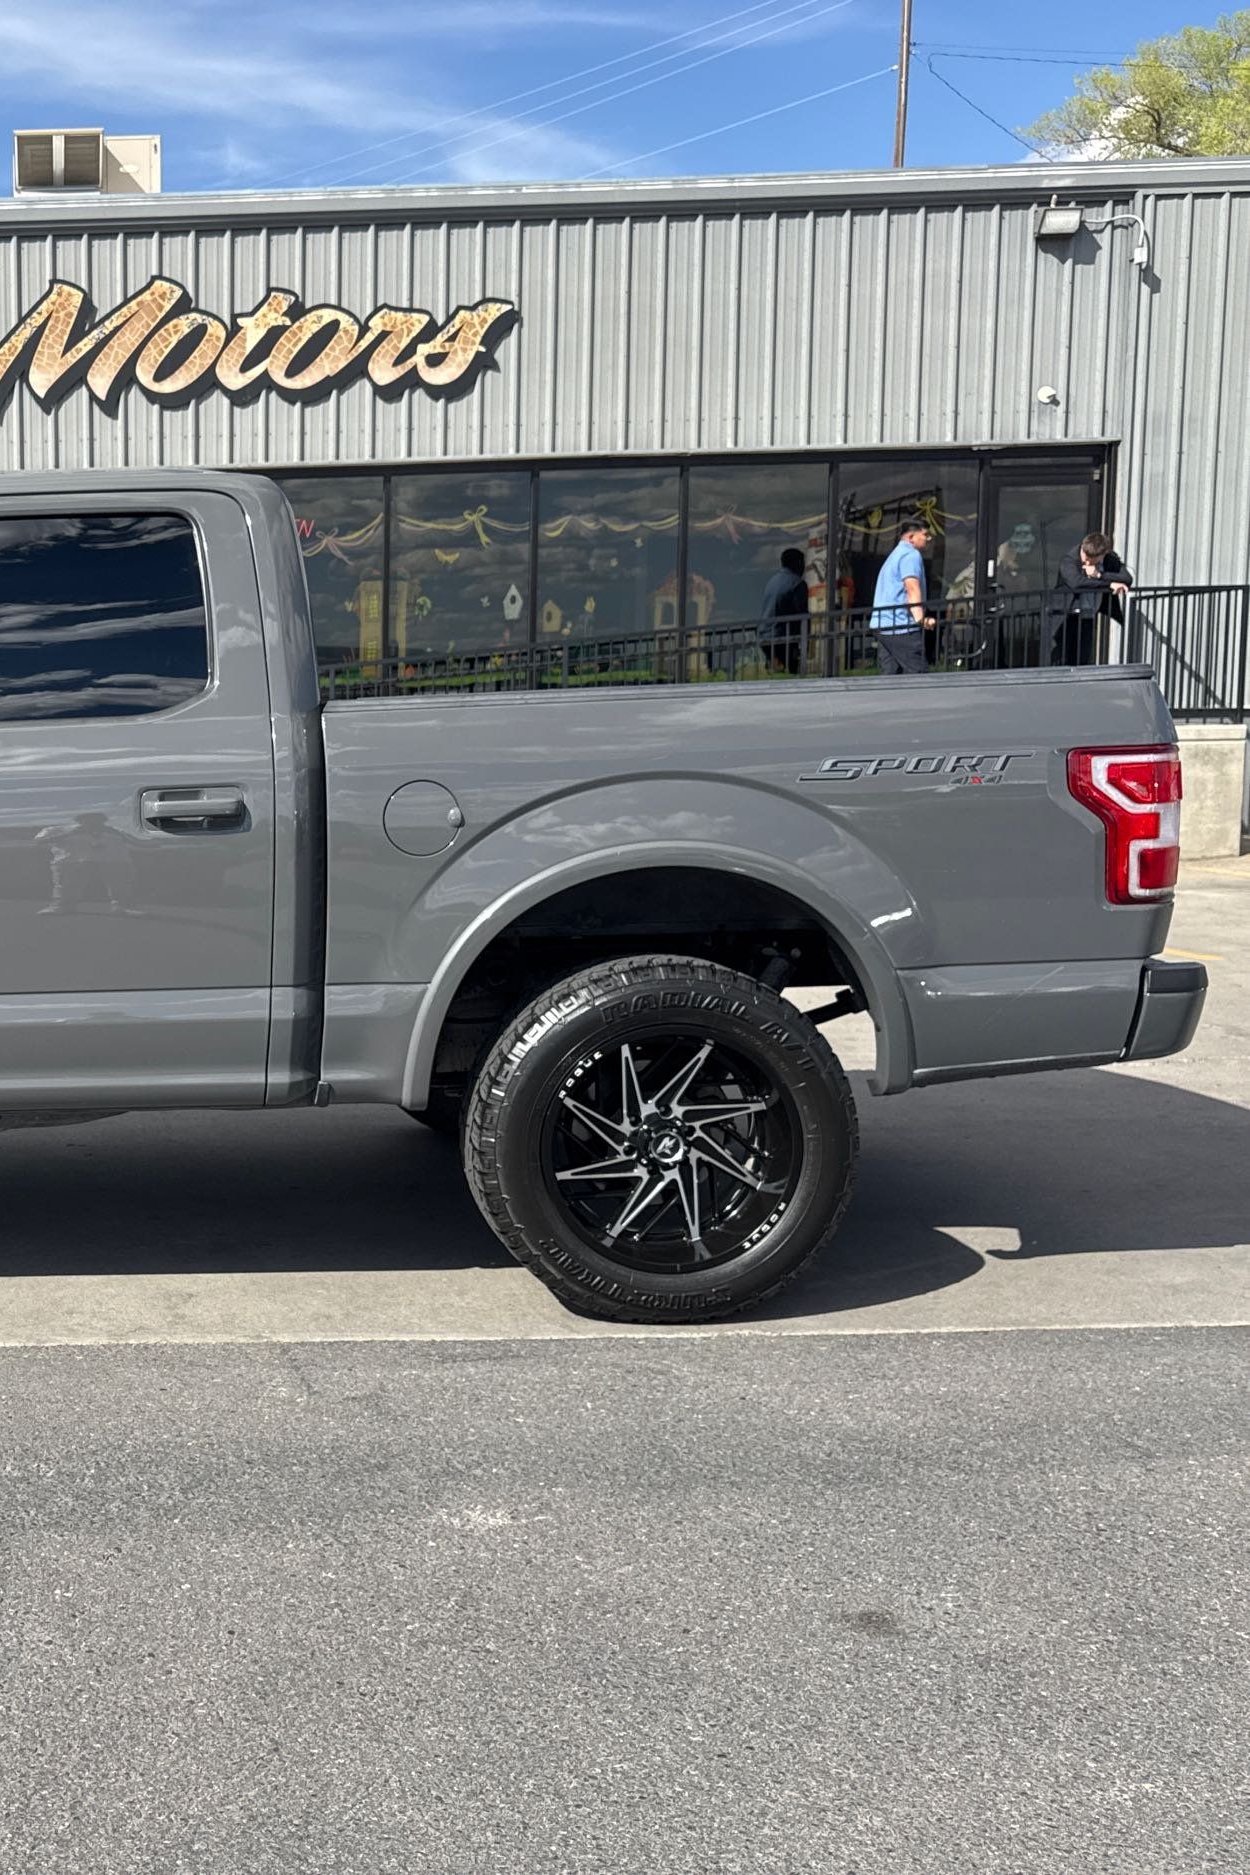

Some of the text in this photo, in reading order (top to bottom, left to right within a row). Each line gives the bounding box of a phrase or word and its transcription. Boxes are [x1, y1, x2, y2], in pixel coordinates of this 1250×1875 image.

[797, 750, 1037, 783] SPORT
[601, 991, 752, 1024] RADIAL
[556, 1049, 605, 1100] ROGUE
[741, 1200, 788, 1251] ROGUE
